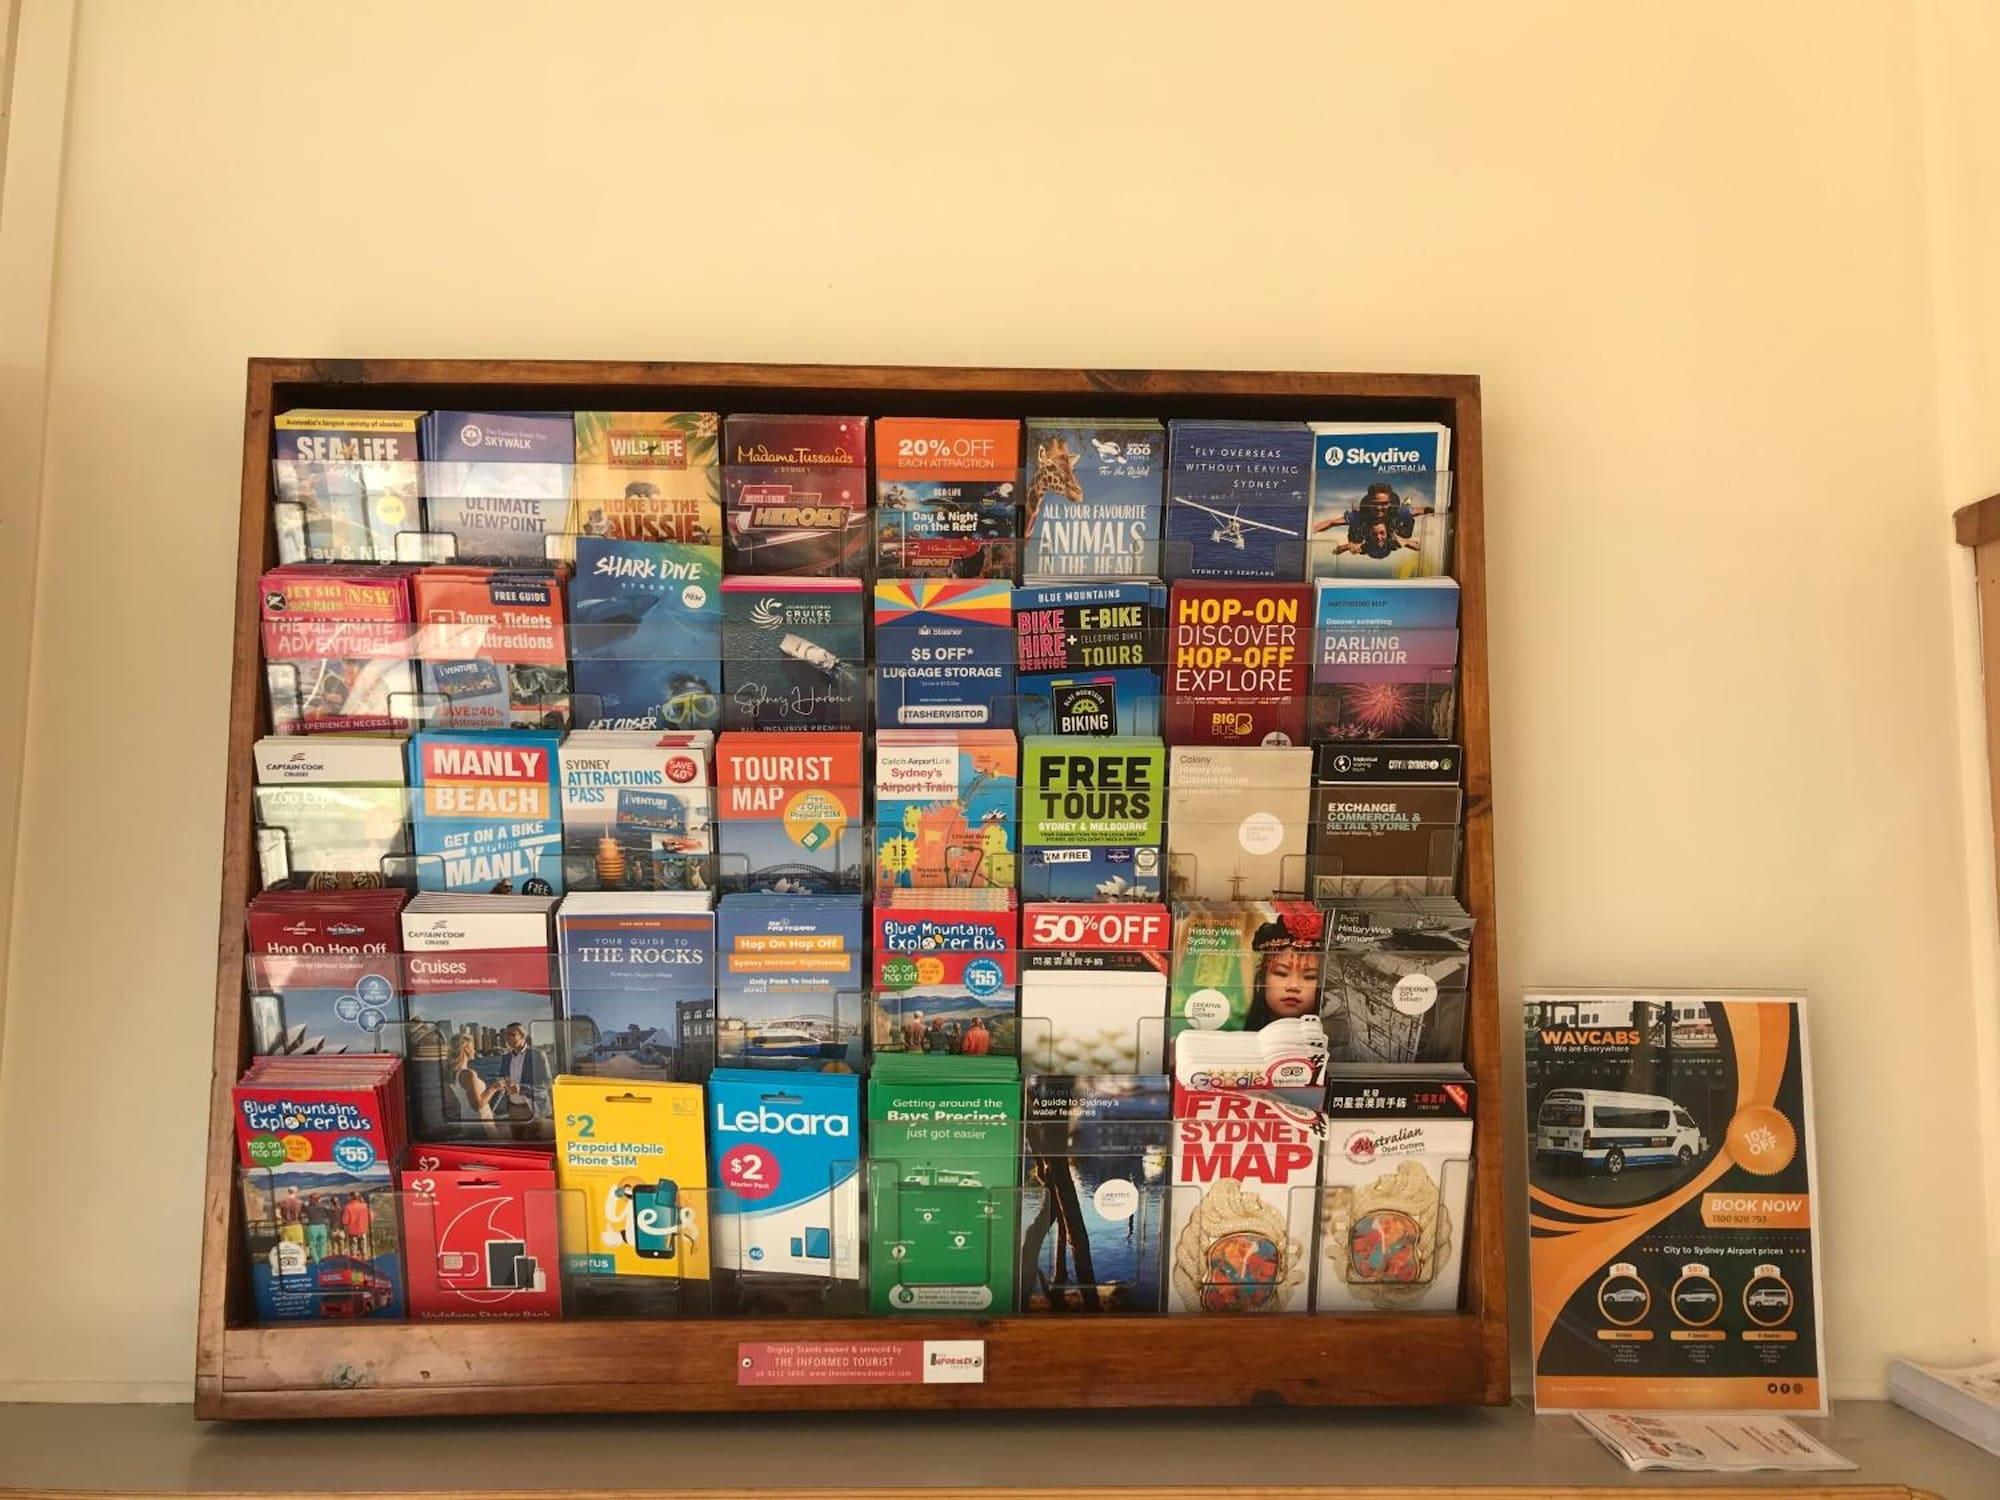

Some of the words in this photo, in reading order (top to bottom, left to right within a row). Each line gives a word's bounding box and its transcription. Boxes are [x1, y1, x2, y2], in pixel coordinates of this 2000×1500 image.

[485, 436, 532, 450] SKYWALK
[610, 438, 650, 457] WILD
[653, 438, 683, 456] LIFE
[899, 439, 950, 456] 20%
[954, 439, 995, 457] OFF
[738, 444, 798, 464] Madame
[799, 447, 854, 465] Tussauds
[1126, 447, 1152, 456] ZOO
[1347, 447, 1420, 471] Skydive
[899, 458, 928, 469] EACH
[929, 458, 995, 469] ATTRACTION
[1185, 463, 1241, 473] WITHOUT
[1247, 464, 1299, 475] LEAVING
[1377, 464, 1427, 473] AUSTRALIA
[466, 498, 540, 516] ULTIMATE
[1043, 505, 1061, 520] ALL
[1064, 505, 1090, 519] YOUR
[1093, 504, 1147, 519] FAVOURITE
[460, 512, 547, 533] VIEWPOINT
[912, 512, 935, 523] Day
[937, 512, 946, 521] &
[949, 512, 978, 523] Night
[914, 524, 928, 532] on
[931, 522, 951, 532] the
[952, 522, 978, 532] Reef
[1039, 522, 1147, 555] ANIMALS
[593, 555, 656, 579] SHARK
[660, 558, 702, 581] DIVE
[1038, 557, 1053, 575] IN
[1061, 557, 1091, 575] THE
[1100, 557, 1143, 575] HEART
[494, 591, 516, 602] FREE
[519, 592, 546, 602] GUIDE
[1038, 592, 1062, 603] BLUE
[1065, 589, 1121, 602] MOUNTAINS
[786, 610, 831, 618] CRUISE
[1079, 606, 1143, 630] E-BIKE
[1178, 598, 1298, 625] HOP-ON
[786, 617, 832, 625] SYDNEY
[1017, 609, 1065, 634] BIKE
[1178, 624, 1296, 647] DISCOVER
[1325, 636, 1400, 650] DARLING
[1018, 634, 1066, 658] HIRE
[911, 647, 931, 661] $5
[1081, 644, 1144, 667] TOURS
[1177, 646, 1295, 668] HOP-OFF
[1323, 651, 1408, 665] HARBOUR
[1019, 655, 1068, 672] SERVICE
[882, 667, 942, 679] LUGGAGE
[944, 667, 1002, 678] STORAGE
[1175, 669, 1293, 692] EXPLORE
[1061, 714, 1109, 733] BIKING
[1212, 712, 1235, 725] BIG
[433, 748, 540, 778] MANLY
[566, 759, 611, 770] SYDNEY
[670, 760, 694, 770] SAVE
[881, 757, 906, 766] Catch
[907, 757, 951, 767] AirportLink
[1179, 755, 1212, 766] Colony
[730, 756, 833, 781] TOURIST
[891, 766, 943, 780] Sydney's
[1040, 756, 1152, 790] FREE
[567, 770, 663, 785] ATTRACTIONS
[880, 782, 921, 794] Airport
[925, 781, 953, 793] Train
[435, 785, 539, 814] BEACH
[568, 788, 605, 803] PASS
[732, 787, 784, 811] MAP
[1040, 792, 1151, 820] TOURS
[1327, 802, 1397, 813] EXCHANGE
[1327, 812, 1409, 823] COMMERCIAL
[1411, 812, 1422, 822] &
[444, 833, 472, 848] GET
[475, 830, 494, 844] ON
[498, 827, 508, 840] A
[512, 820, 545, 836] BIKE
[1038, 822, 1077, 832] SYDNEY
[1080, 823, 1087, 831] &
[1089, 822, 1148, 832] MELBOURNE
[1326, 822, 1368, 831] RETAIL
[1370, 822, 1419, 832] SYDNEY
[448, 846, 545, 888] MANLY
[1339, 914, 1355, 924] Port
[884, 920, 916, 936] Blue
[922, 920, 995, 936] Mountains
[1033, 914, 1098, 943] 50%
[1099, 915, 1160, 943] OFF
[630, 938, 666, 946] GUIDE
[674, 938, 689, 946] TO
[740, 939, 766, 951] Hop
[768, 939, 787, 950] On
[789, 939, 815, 951] Hop
[816, 938, 838, 949] Off
[1187, 936, 1227, 946] Sydney's
[1336, 933, 1375, 944] Pyrmont
[578, 947, 625, 963] THE
[629, 947, 704, 965] ROCKS
[410, 958, 467, 974] Cruises
[970, 969, 997, 986] $55
[1540, 1031, 1641, 1044] WAVCABS
[1553, 1045, 1568, 1053] We
[1583, 1045, 1630, 1054] Everywhere
[244, 1100, 277, 1115] Blue
[282, 1101, 359, 1116] Mountains
[892, 1098, 936, 1110] Getting
[939, 1098, 981, 1108] around
[984, 1098, 1003, 1108] the
[1032, 1098, 1040, 1106] A
[1041, 1098, 1067, 1108] guide
[1068, 1098, 1078, 1106] to
[1079, 1098, 1120, 1109] Sydney's
[1186, 1095, 1282, 1120] FRE
[566, 1114, 595, 1138] $2
[717, 1103, 849, 1137] Lebara
[906, 1128, 926, 1140] just
[931, 1129, 951, 1140] got
[953, 1129, 987, 1140] easier
[1180, 1120, 1310, 1144] SYDNEY
[1743, 1124, 1773, 1145] 10%
[339, 1145, 368, 1162] $55
[567, 1141, 617, 1155] Prepaid
[620, 1142, 664, 1155] Mobile
[1381, 1145, 1399, 1154] Opal
[1749, 1138, 1779, 1156] OFF
[568, 1154, 609, 1166] Phone
[611, 1155, 637, 1167] SIM
[730, 1154, 763, 1180] $2
[1180, 1143, 1315, 1185] MAP
[411, 1178, 436, 1194] $2
[1711, 1199, 1758, 1212] BOOK
[1762, 1199, 1802, 1212] NOW
[1663, 1246, 1680, 1256] City
[1682, 1247, 1692, 1255] to
[1693, 1246, 1725, 1257] Sydney
[1727, 1246, 1756, 1257] Airport
[1757, 1247, 1784, 1257] prices
[767, 1345, 794, 1355] Display
[774, 1357, 793, 1367] THE
[796, 1357, 849, 1367] INFORMED
[852, 1356, 894, 1367] TOURIST
